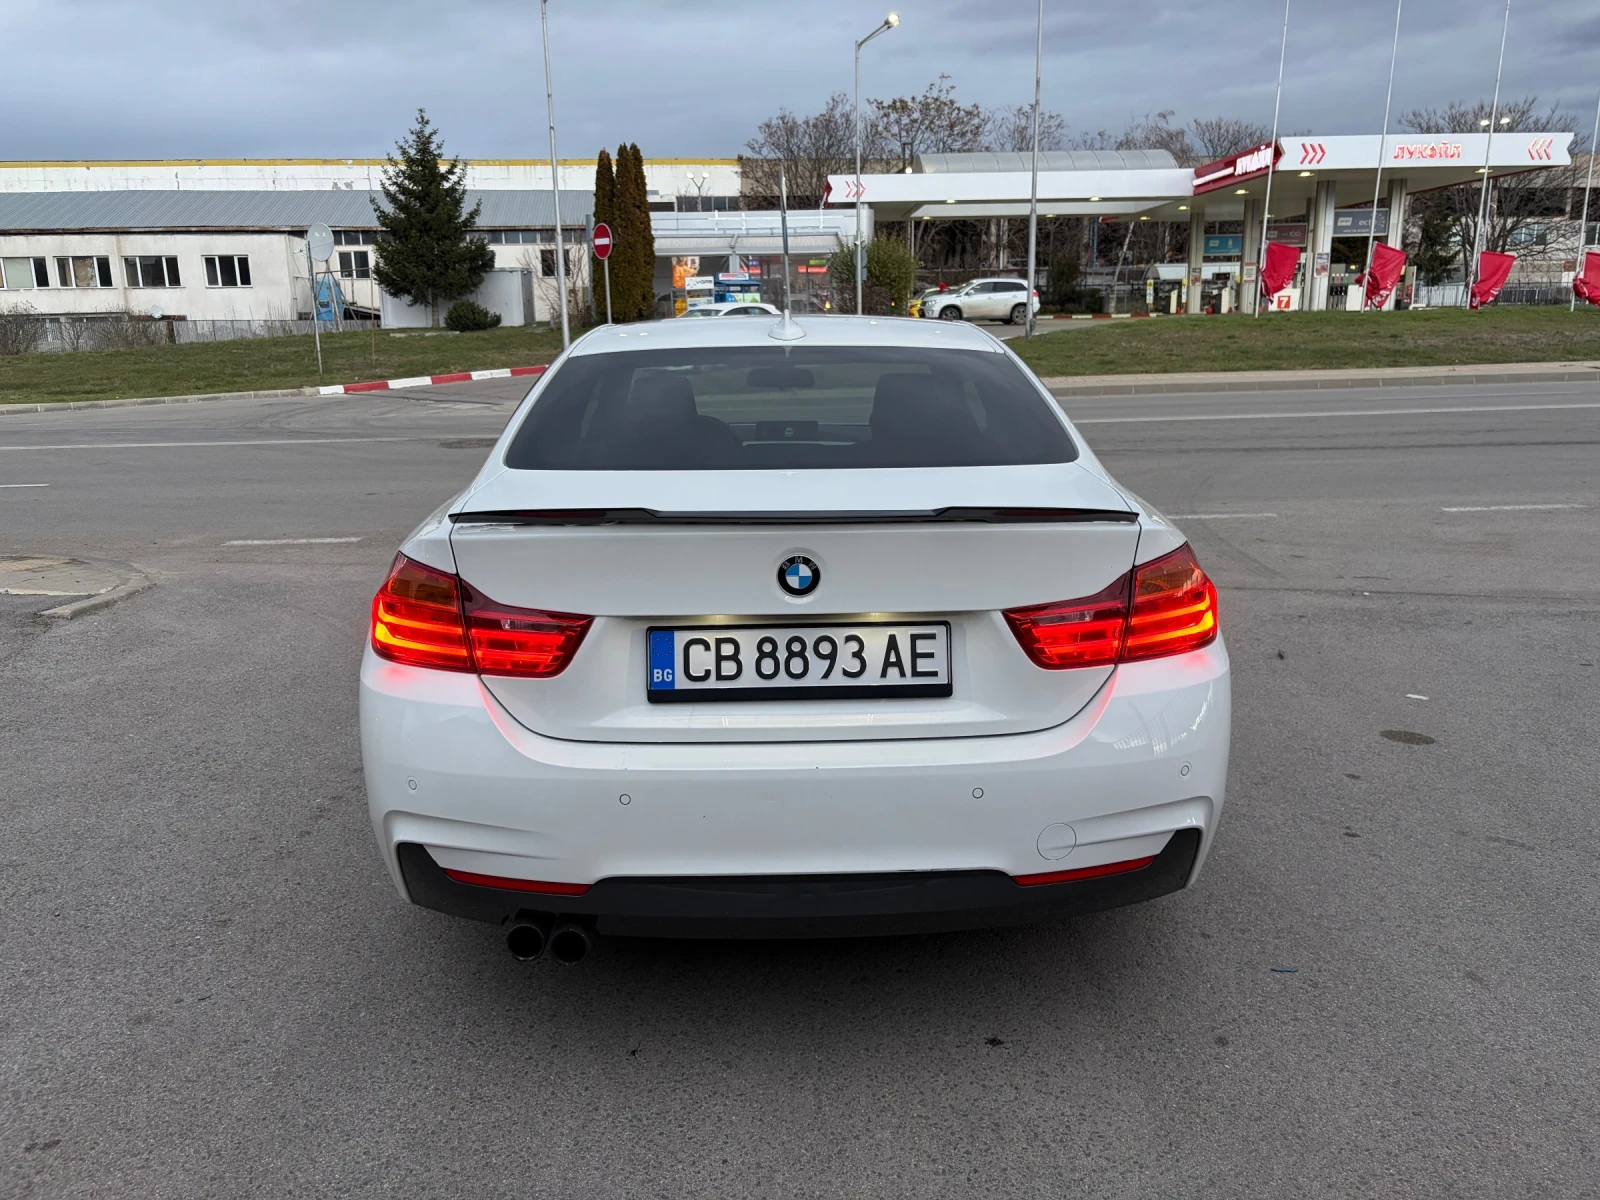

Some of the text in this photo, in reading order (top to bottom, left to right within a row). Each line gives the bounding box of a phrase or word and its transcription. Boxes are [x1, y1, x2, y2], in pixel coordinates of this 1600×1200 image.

[1393, 140, 1461, 159] ЛУКОЙЛ
[1279, 297, 1288, 308] 7
[781, 556, 818, 570] BMW
[683, 633, 938, 682] CB 8893 AE
[653, 669, 673, 682] BG
